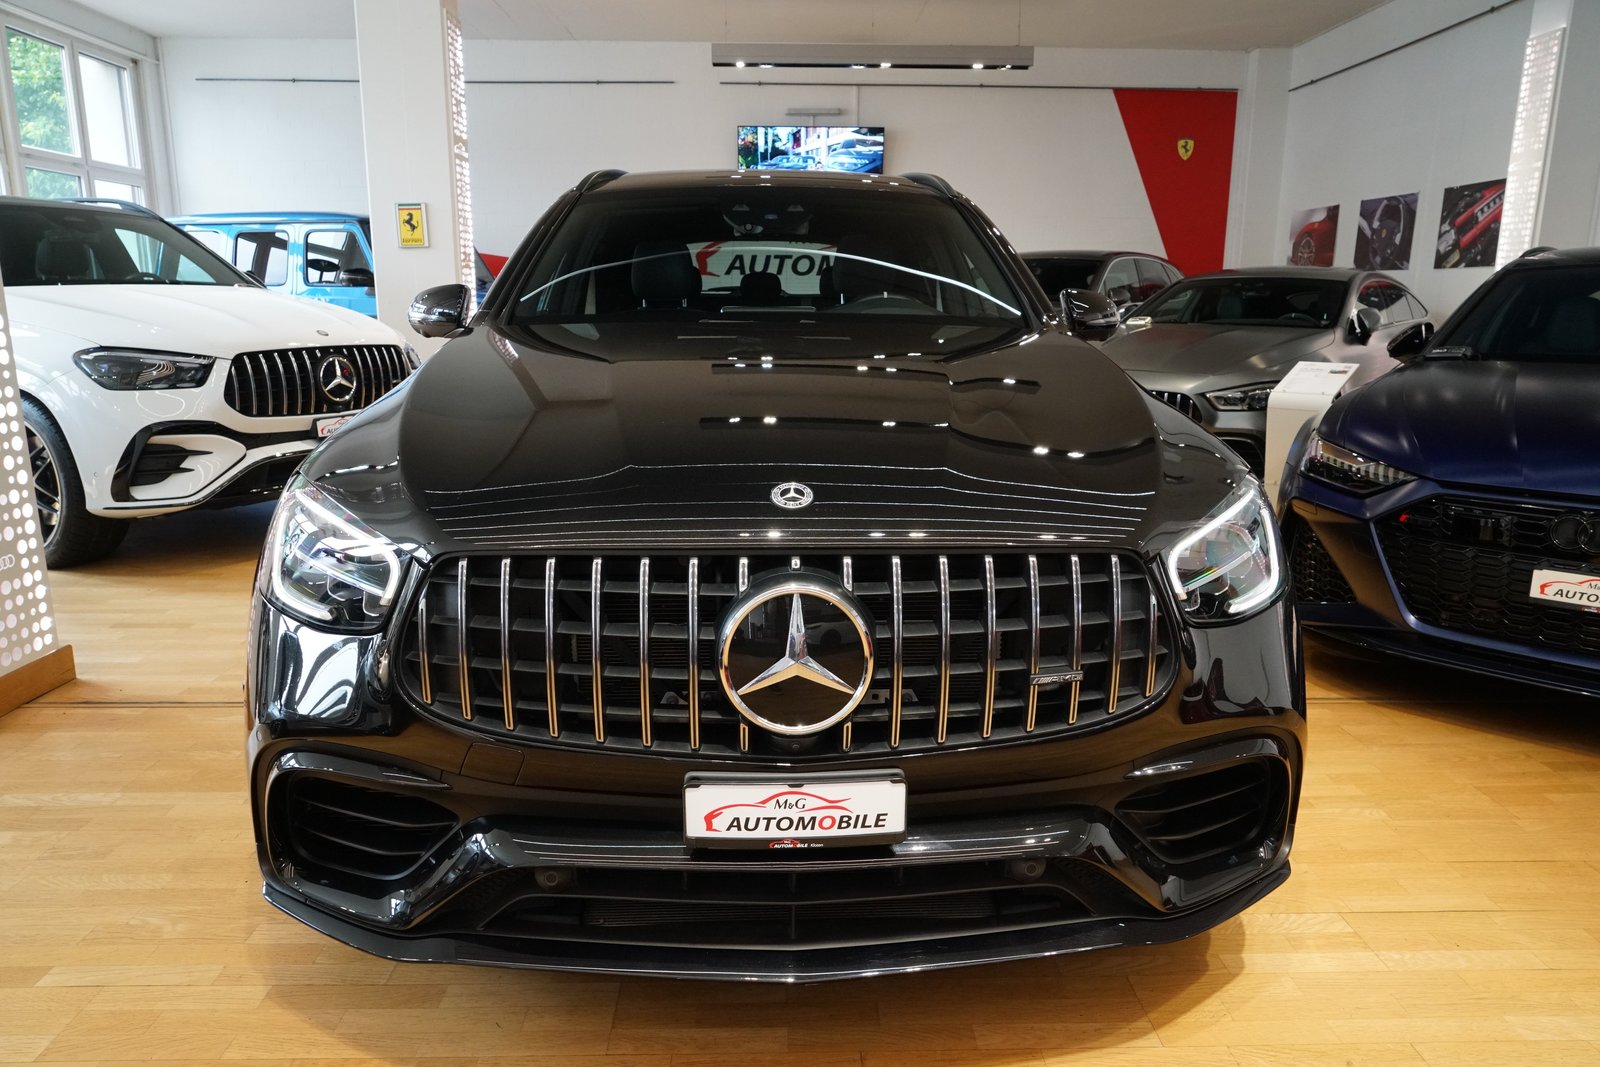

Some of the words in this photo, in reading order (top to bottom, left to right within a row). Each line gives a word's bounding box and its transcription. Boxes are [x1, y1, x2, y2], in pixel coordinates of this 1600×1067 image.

[1553, 588, 1600, 603] AUTO
[774, 798, 807, 810] M&G
[726, 813, 889, 832] AUTOMOBILE
